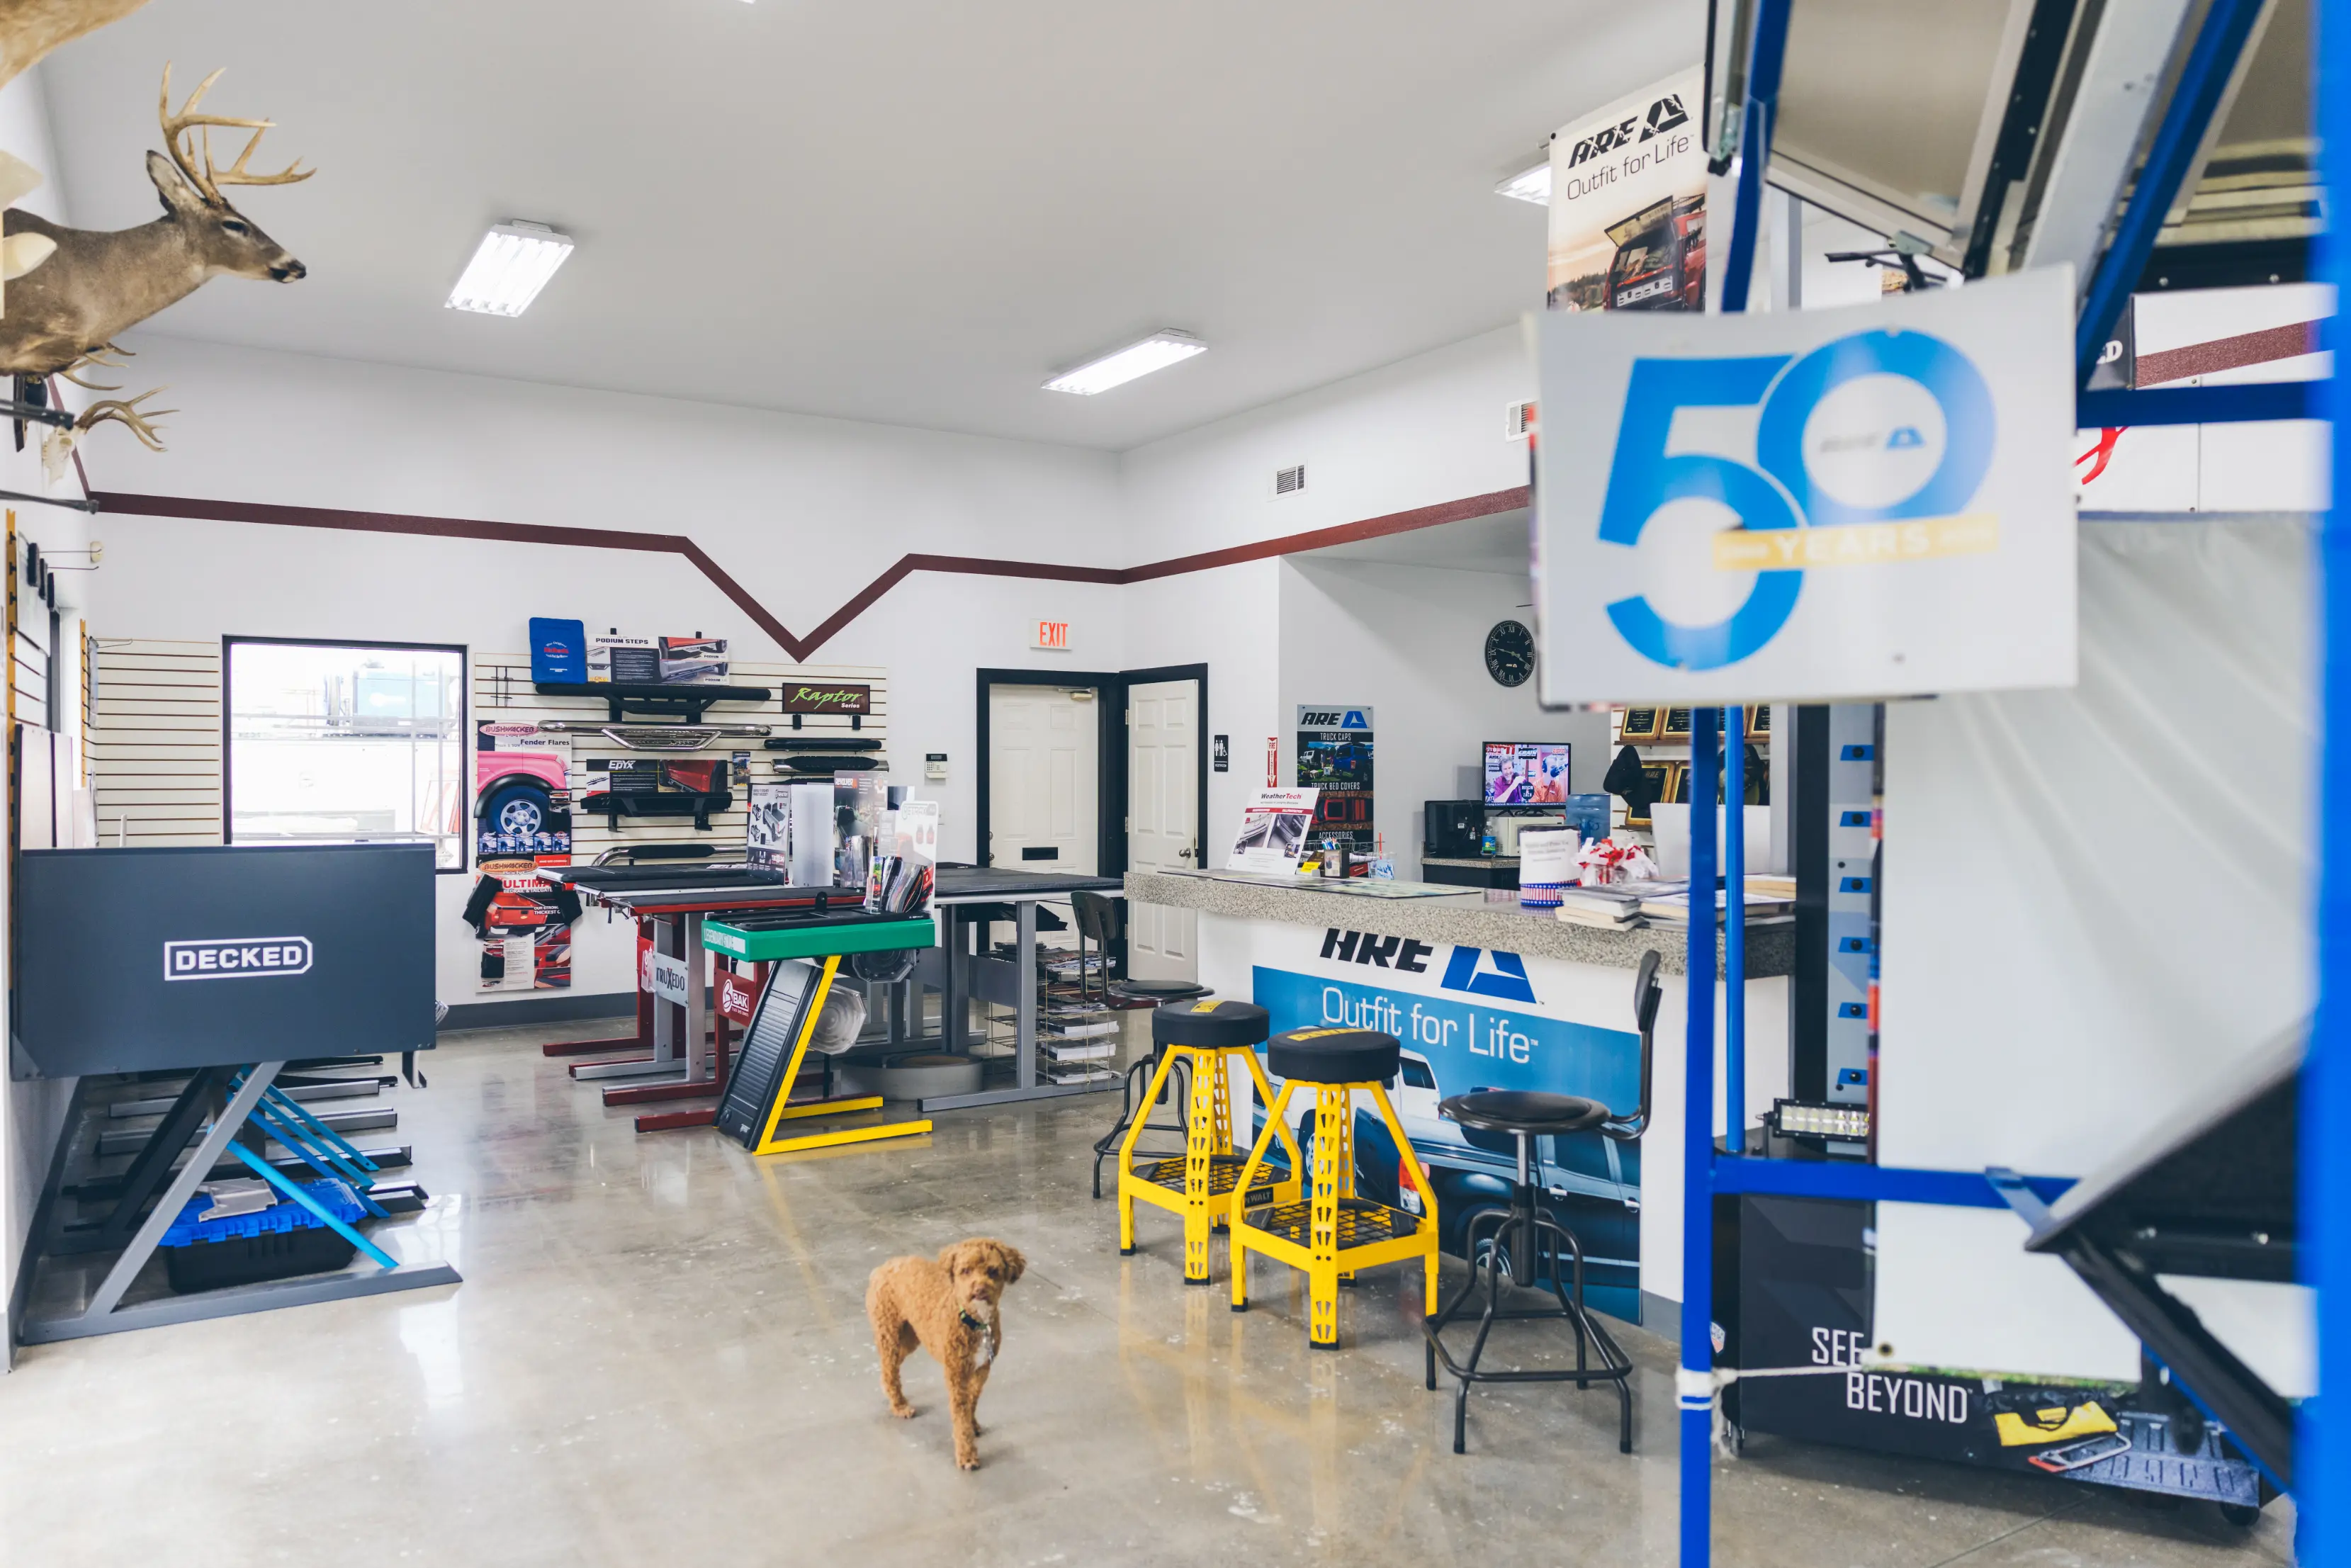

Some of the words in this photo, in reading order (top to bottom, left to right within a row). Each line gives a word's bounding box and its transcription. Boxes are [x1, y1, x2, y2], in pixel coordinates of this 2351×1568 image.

[1567, 115, 1638, 169] ARE
[1567, 166, 1618, 200] Outfit
[1623, 153, 1650, 177] for
[1655, 135, 1689, 164] Life
[1597, 325, 1997, 672] 50
[1774, 523, 1931, 562] YEARS
[1039, 621, 1069, 647] EXIT
[790, 687, 864, 709] Raptor
[1301, 713, 1341, 726] ARE
[1320, 733, 1337, 741] TRUCK
[1338, 733, 1351, 741] CAPS
[1341, 782, 1360, 790] COVERS
[1319, 831, 1353, 840] ACCESSORIES
[176, 946, 303, 971] DECKED
[656, 967, 685, 991] TRUXEDO
[733, 993, 748, 1008] BAK
[1322, 987, 1402, 1037] Outfit
[1410, 1003, 1458, 1047] for
[1812, 1326, 1864, 1367] SEE
